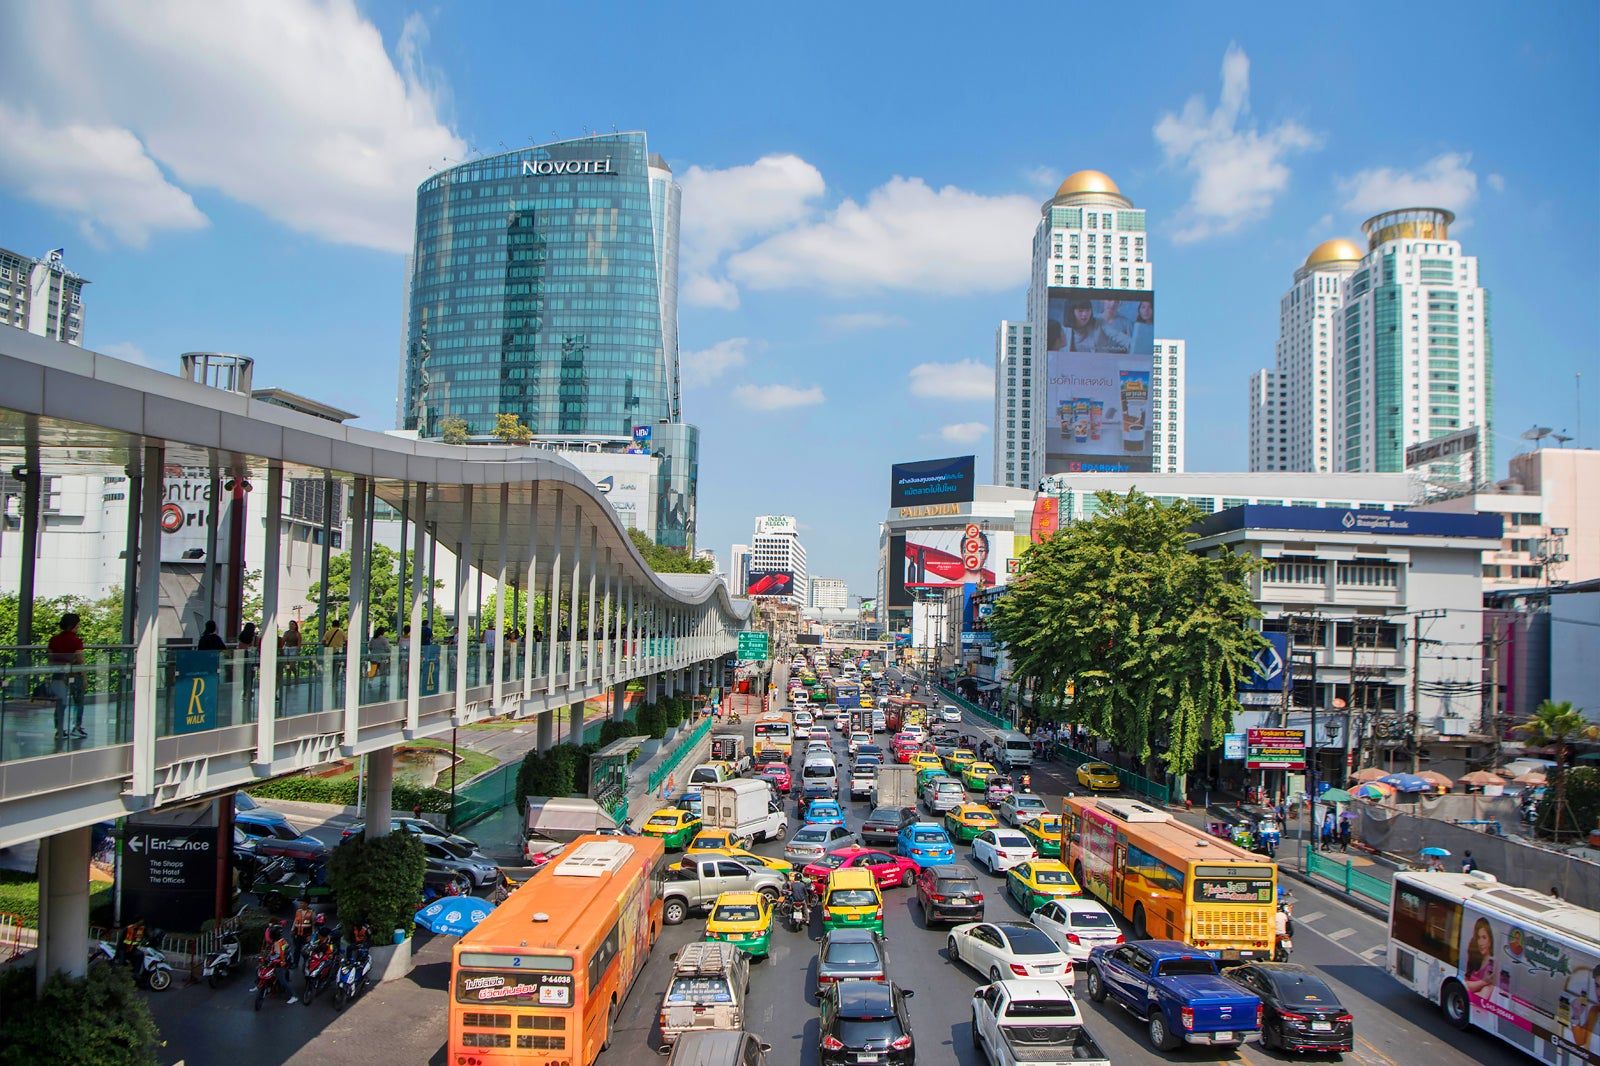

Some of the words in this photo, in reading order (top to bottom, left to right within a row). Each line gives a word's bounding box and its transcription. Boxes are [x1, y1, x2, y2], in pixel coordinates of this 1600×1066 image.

[522, 158, 610, 175] NOVOTEL
[900, 503, 960, 518] PALLADIUM
[187, 677, 205, 715] R
[186, 715, 205, 725] WALK
[512, 957, 521, 967] 2
[541, 975, 571, 984] 3-44038
